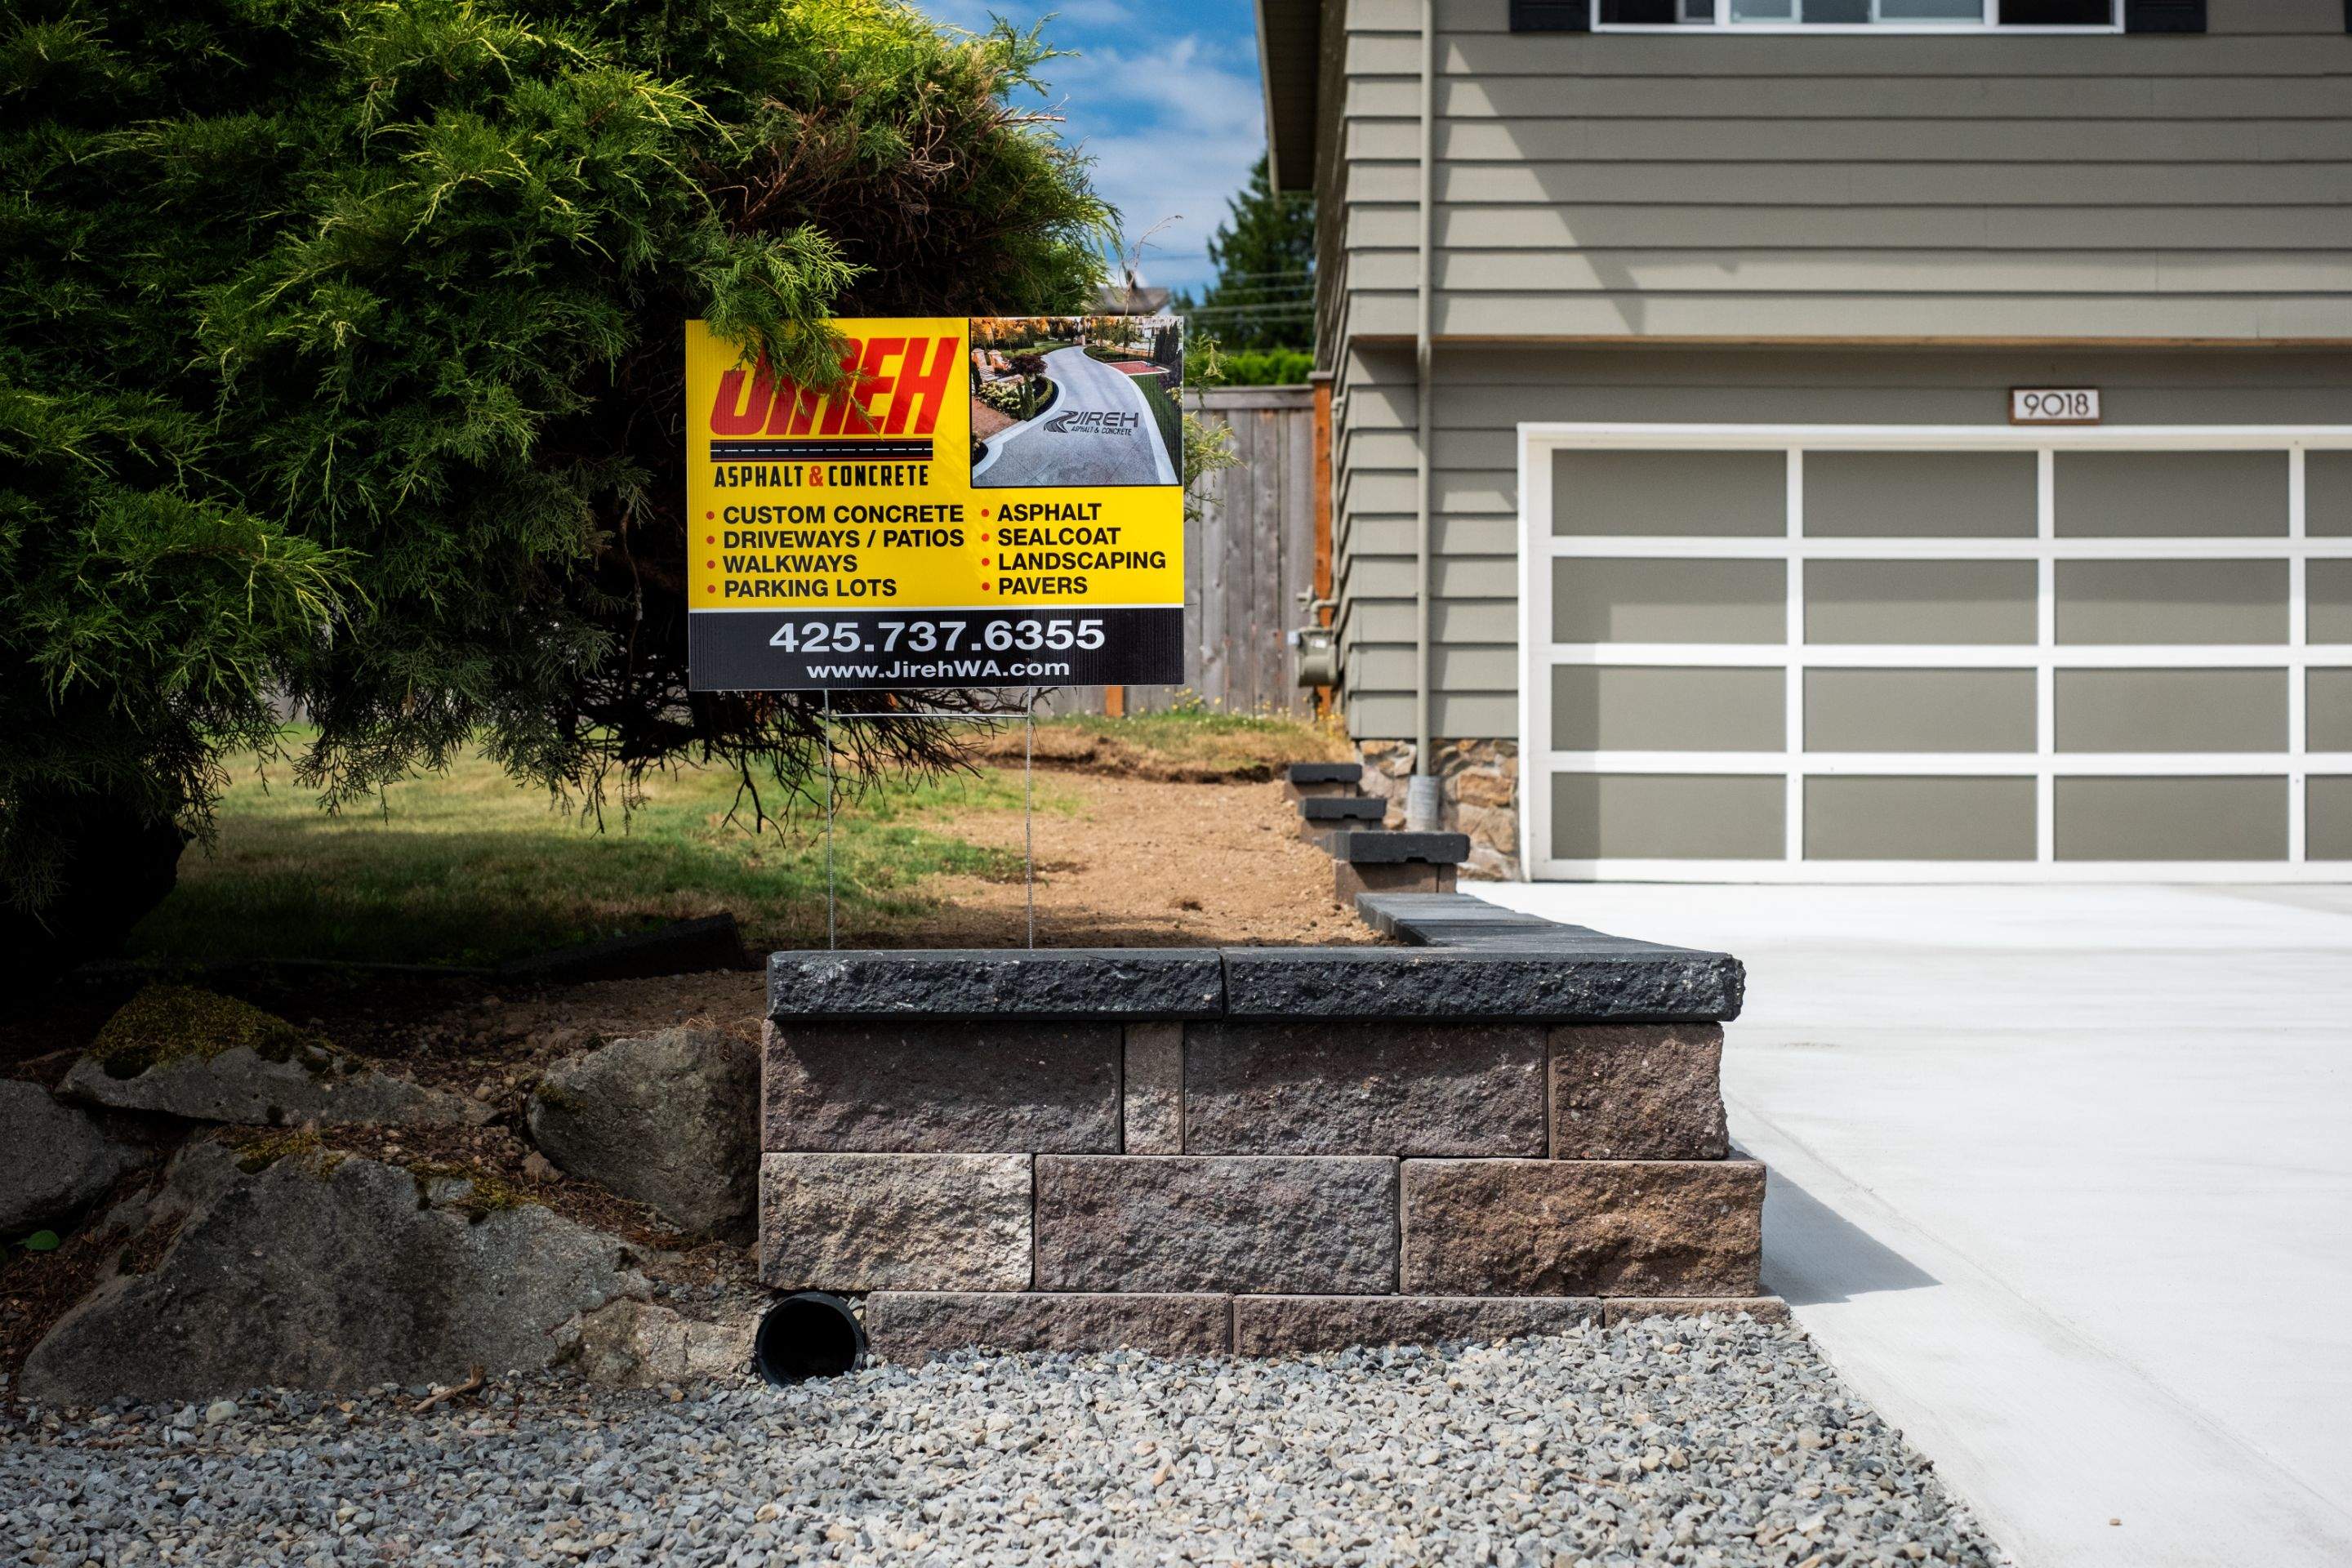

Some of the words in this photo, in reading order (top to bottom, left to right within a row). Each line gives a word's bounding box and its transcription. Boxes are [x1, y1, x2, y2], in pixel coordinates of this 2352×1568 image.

[2024, 393, 2089, 416] 9018
[1066, 412, 1138, 428] JIREH
[1071, 425, 1093, 434] ASPHALT
[1101, 427, 1132, 436] CONCRETE
[714, 466, 804, 488] ASPHALT
[808, 465, 824, 488] &
[828, 465, 929, 487] CONCRETE
[723, 506, 826, 525] CUSTOM
[833, 504, 964, 523] CONCRETE
[997, 503, 1102, 522] ASPHALT
[724, 530, 861, 549] DRIVEWAYS
[866, 530, 876, 548] /
[883, 528, 965, 547] PATIOS
[997, 527, 1121, 546] SEALCOAT
[723, 555, 858, 573] WALKWAYS
[999, 550, 1166, 571] LANDSCAPING
[724, 579, 829, 598] PARKING
[836, 578, 898, 597] LOTS
[999, 576, 1088, 595] PAVERS
[768, 619, 1105, 653] 425.737.6355
[806, 660, 1071, 679] www.JirehWA.com
